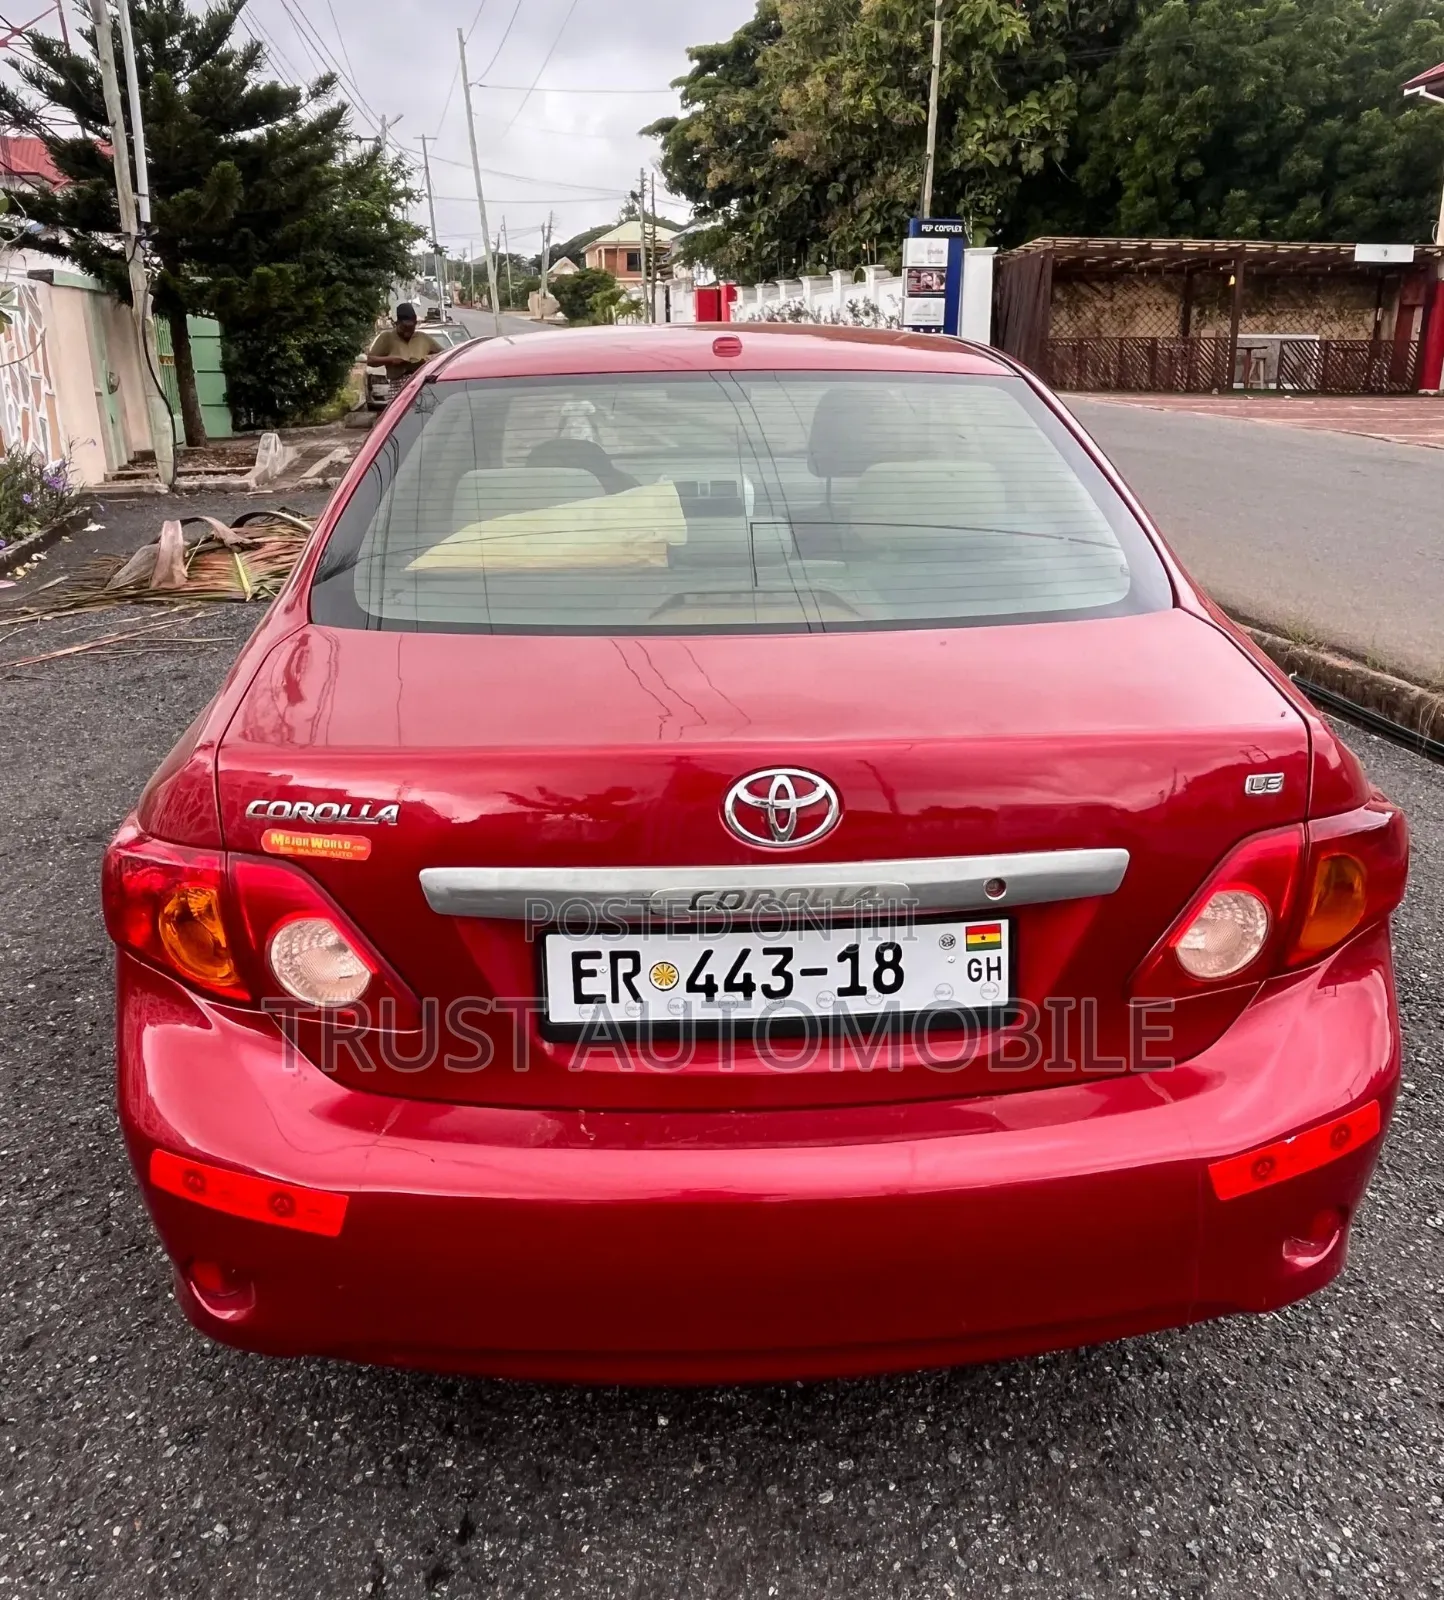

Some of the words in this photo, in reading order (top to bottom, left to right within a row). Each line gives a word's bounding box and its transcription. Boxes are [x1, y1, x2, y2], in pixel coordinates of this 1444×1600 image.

[934, 224, 963, 233] COMPLEX
[1245, 772, 1285, 795] LE
[245, 800, 400, 825] COROLLA
[686, 885, 880, 913] COROLLA
[572, 950, 643, 1004] ER
[686, 942, 904, 1002] 443-18
[967, 956, 1002, 983] GH
